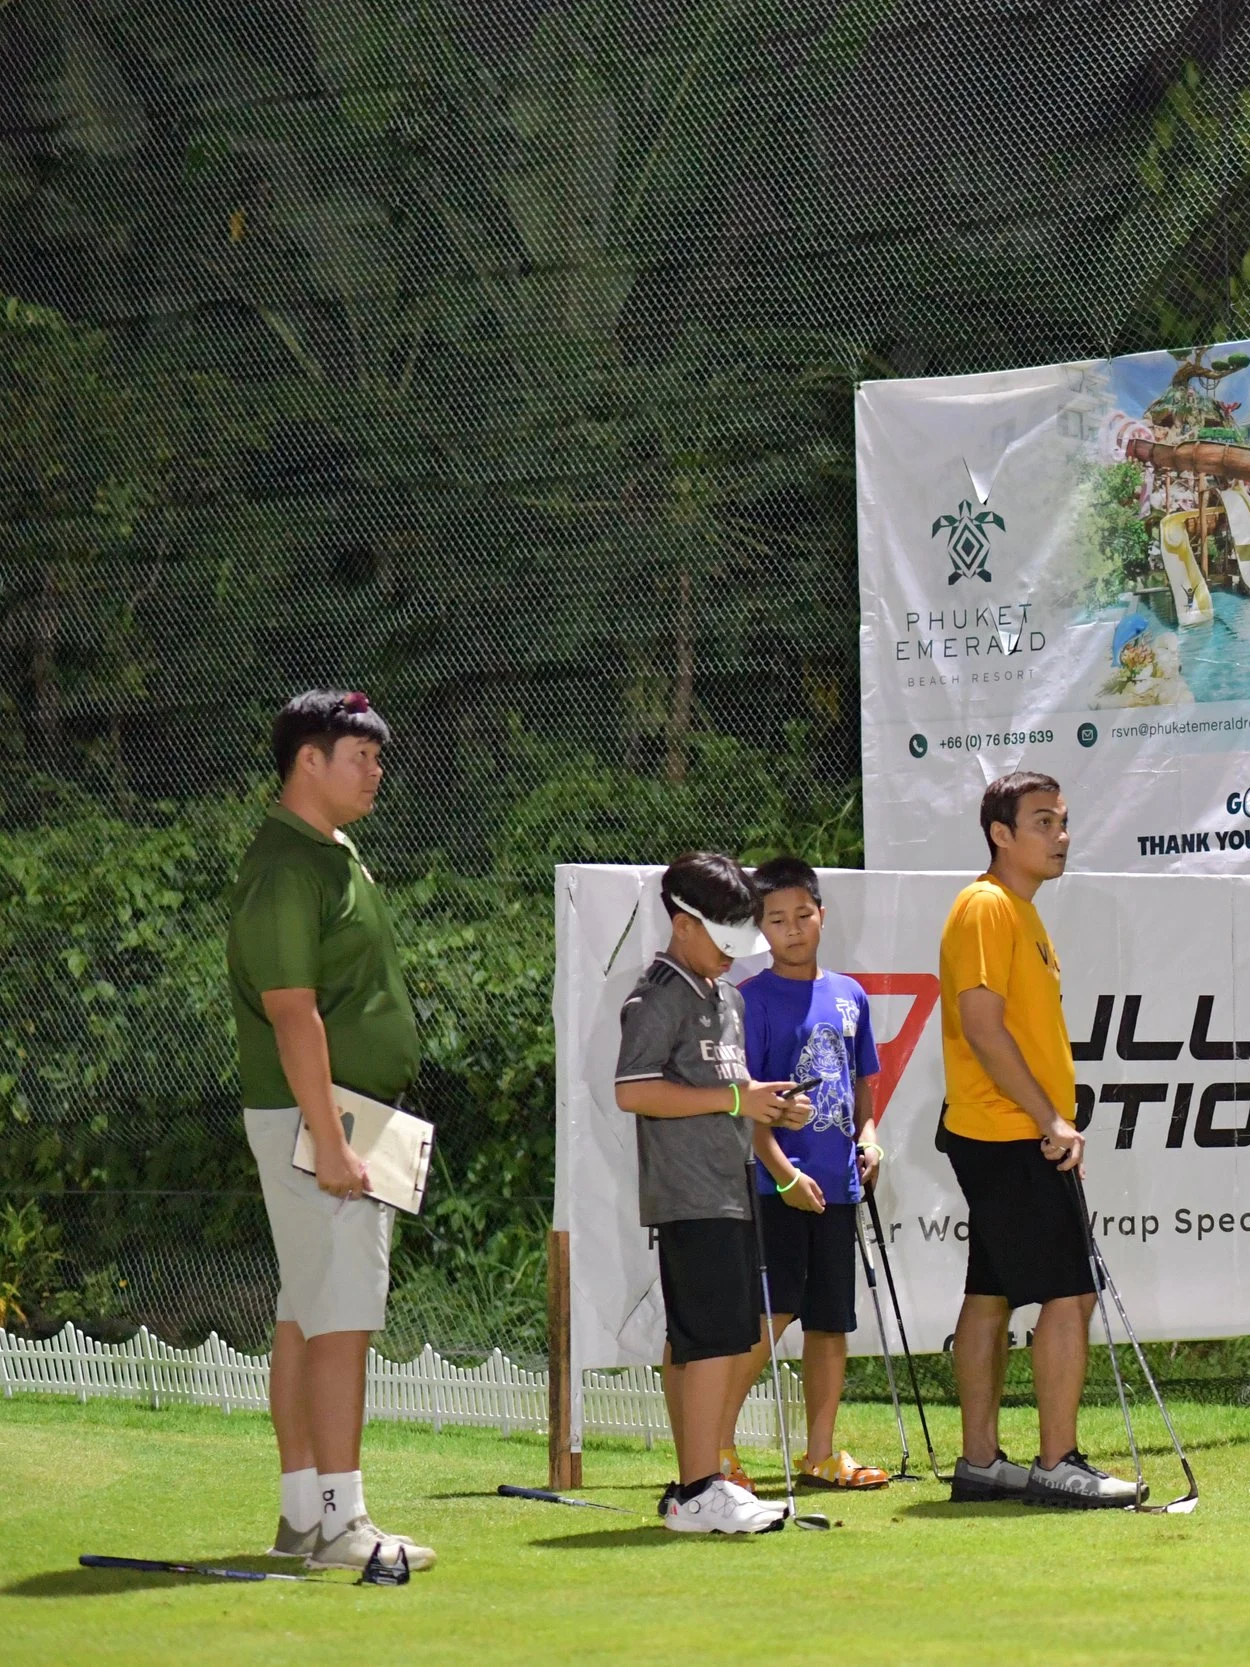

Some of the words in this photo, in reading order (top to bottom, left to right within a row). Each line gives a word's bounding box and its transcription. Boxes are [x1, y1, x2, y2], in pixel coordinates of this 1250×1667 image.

[906, 603, 1032, 632] PHUKET
[896, 631, 1046, 661] EMERALD
[908, 675, 960, 687] BEACH
[971, 669, 1034, 683] RESORT
[939, 736, 962, 750] +66
[965, 734, 982, 751] (0)
[986, 733, 1001, 746] 76
[1003, 731, 1026, 745] 639
[1029, 729, 1054, 744] 639
[1137, 832, 1210, 856] THANK
[1088, 1211, 1160, 1243] rap
